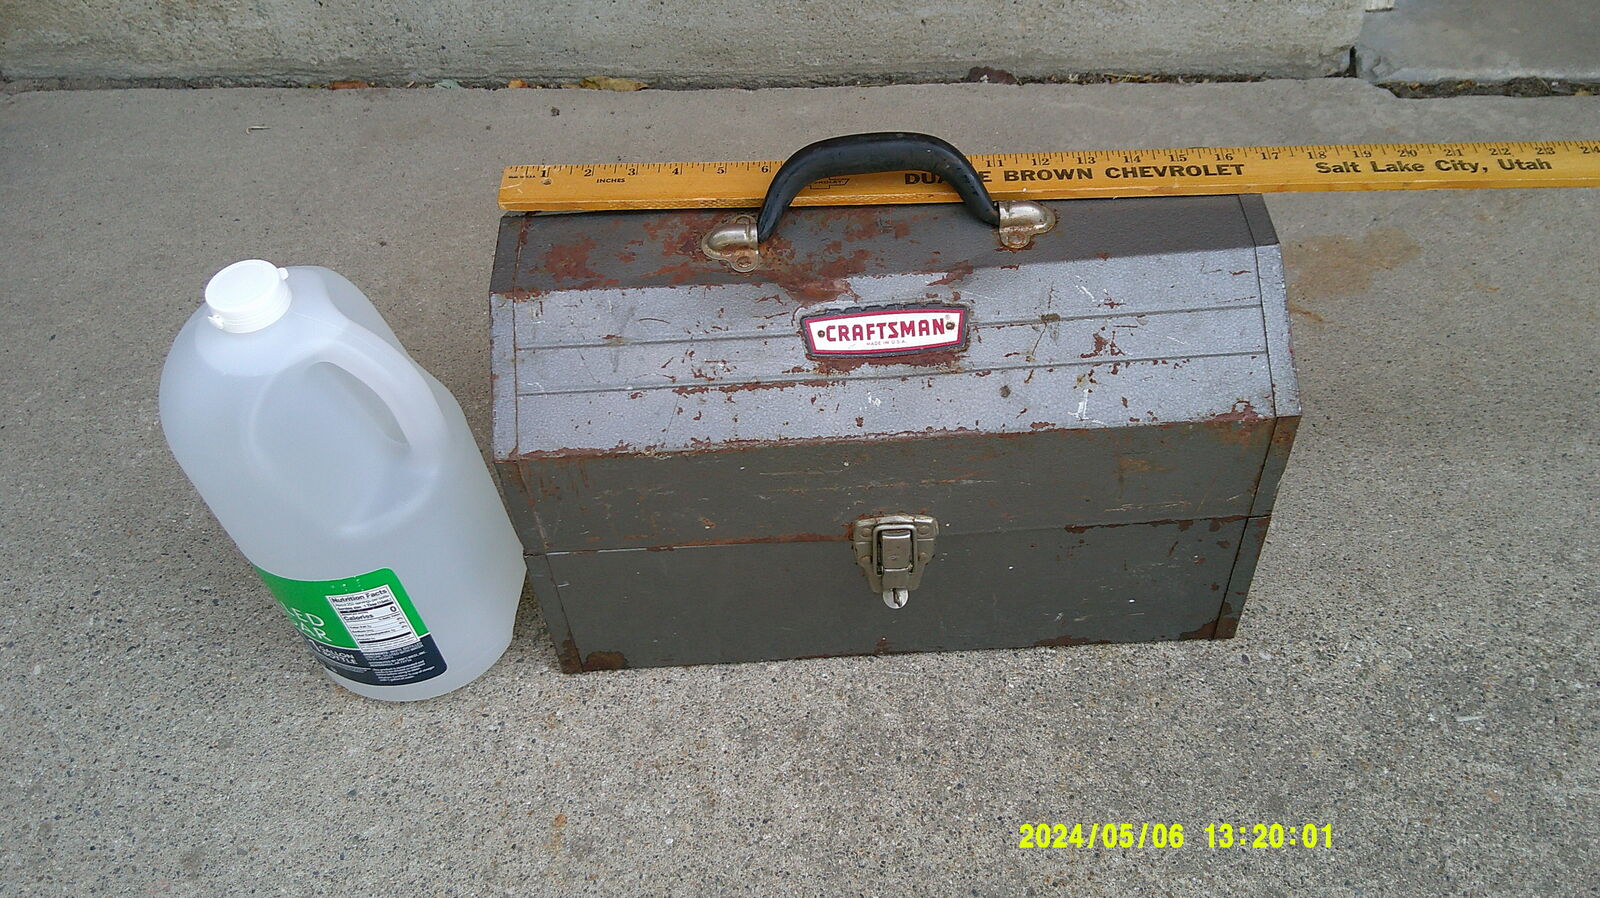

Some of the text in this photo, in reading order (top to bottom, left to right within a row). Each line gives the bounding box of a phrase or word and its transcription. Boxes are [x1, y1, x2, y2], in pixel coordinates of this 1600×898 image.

[628, 168, 636, 176] 3
[672, 167, 679, 175] 4
[717, 166, 725, 174] 5
[762, 165, 769, 173] 6
[1032, 158, 1050, 166] 12
[1077, 156, 1096, 164] 13
[1123, 155, 1142, 163] 14
[1168, 154, 1187, 162] 15
[1215, 153, 1234, 161] 16
[1261, 152, 1279, 160] 17
[1307, 151, 1327, 159] 18
[1352, 150, 1372, 158] 19
[1397, 149, 1418, 157] 20
[1443, 147, 1464, 156] 21
[1488, 147, 1511, 156] 22
[1535, 146, 1556, 155] 23
[1315, 158, 1553, 174] Salt Lake City, Utah
[904, 164, 1245, 185] DUE BROWN CHEVROLET
[826, 317, 946, 342] CRAFTSMAN
[331, 594, 366, 603] Nutrition
[365, 589, 388, 599] Facts
[343, 613, 375, 621] Calories
